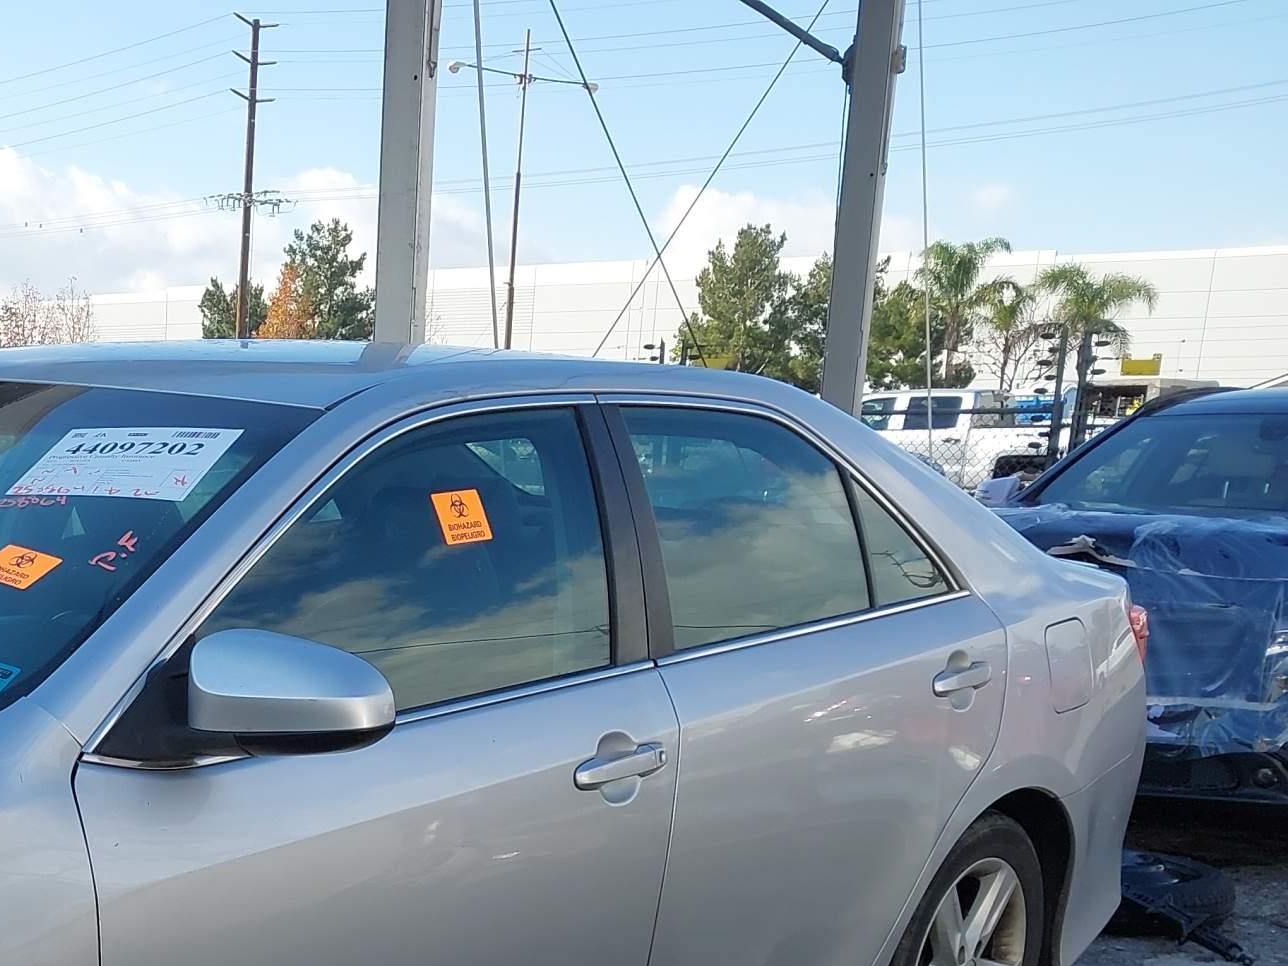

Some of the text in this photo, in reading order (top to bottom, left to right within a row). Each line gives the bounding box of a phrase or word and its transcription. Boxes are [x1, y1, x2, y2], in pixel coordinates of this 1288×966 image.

[65, 441, 205, 457] 44097202
[447, 520, 482, 531] BIOHAZARD
[451, 530, 485, 541] BIOPELIGRO
